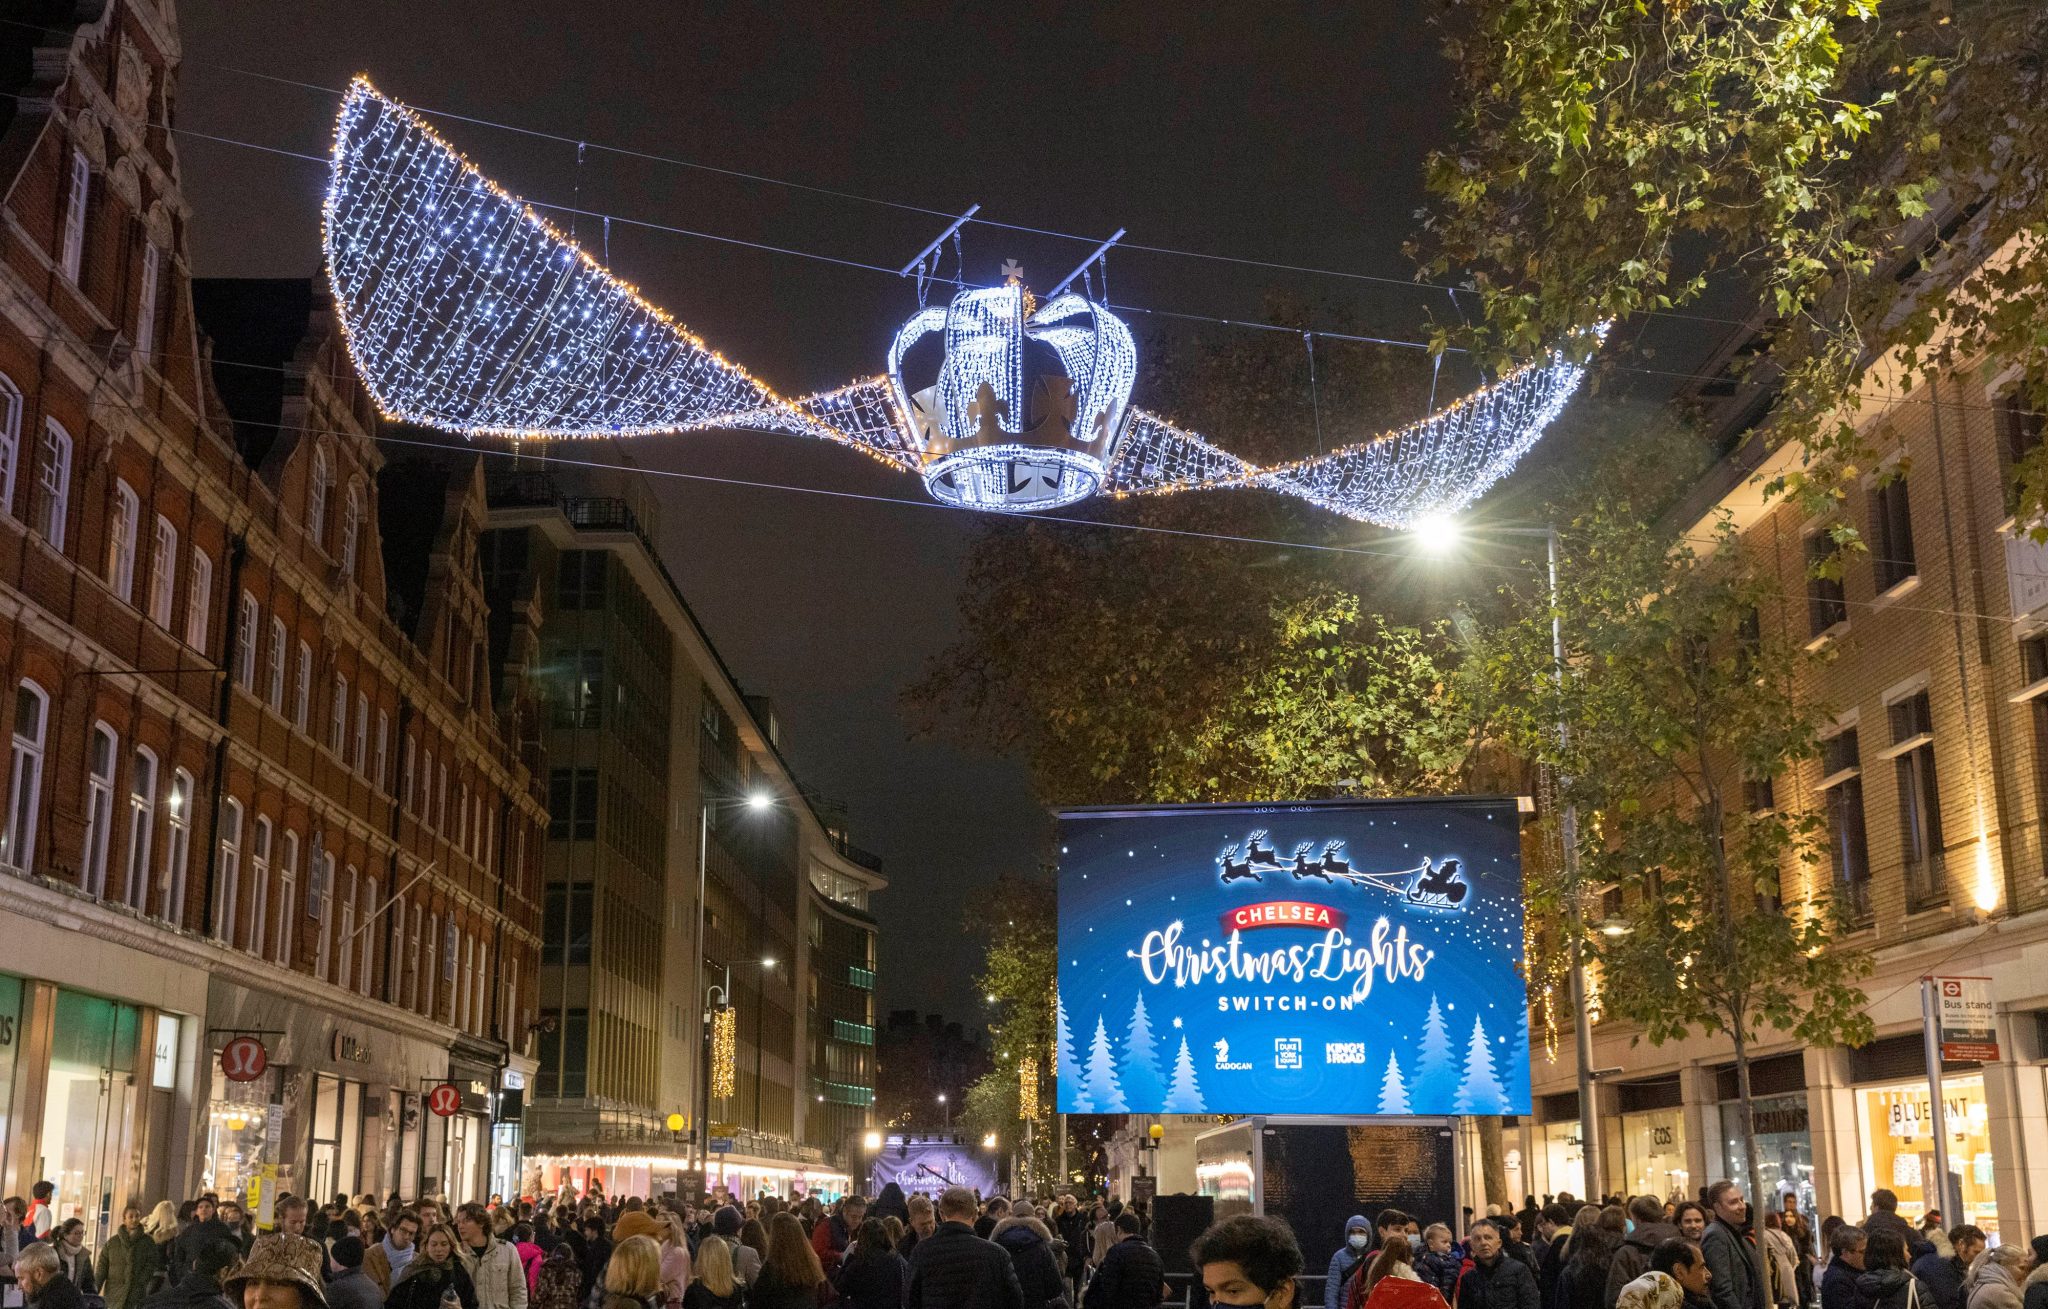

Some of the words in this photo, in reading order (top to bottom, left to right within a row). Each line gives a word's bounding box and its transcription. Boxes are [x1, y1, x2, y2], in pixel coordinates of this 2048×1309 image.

[1235, 905, 1330, 925] CHELSEA
[1127, 919, 1314, 988] Christmas
[1309, 915, 1434, 1005] Lights
[1218, 996, 1355, 1011] SWITCH-ON
[1944, 1000, 1962, 1009] Bus
[1965, 1001, 1992, 1010] stand
[156, 1044, 168, 1063] 44
[1279, 1043, 1297, 1051] DUKE
[1332, 1053, 1366, 1064] ROAD
[1215, 1062, 1253, 1071] CADOGAN
[1893, 1097, 1967, 1123] BLUEINT
[1182, 1115, 1209, 1124] DUKE
[1654, 1126, 1672, 1145] COS
